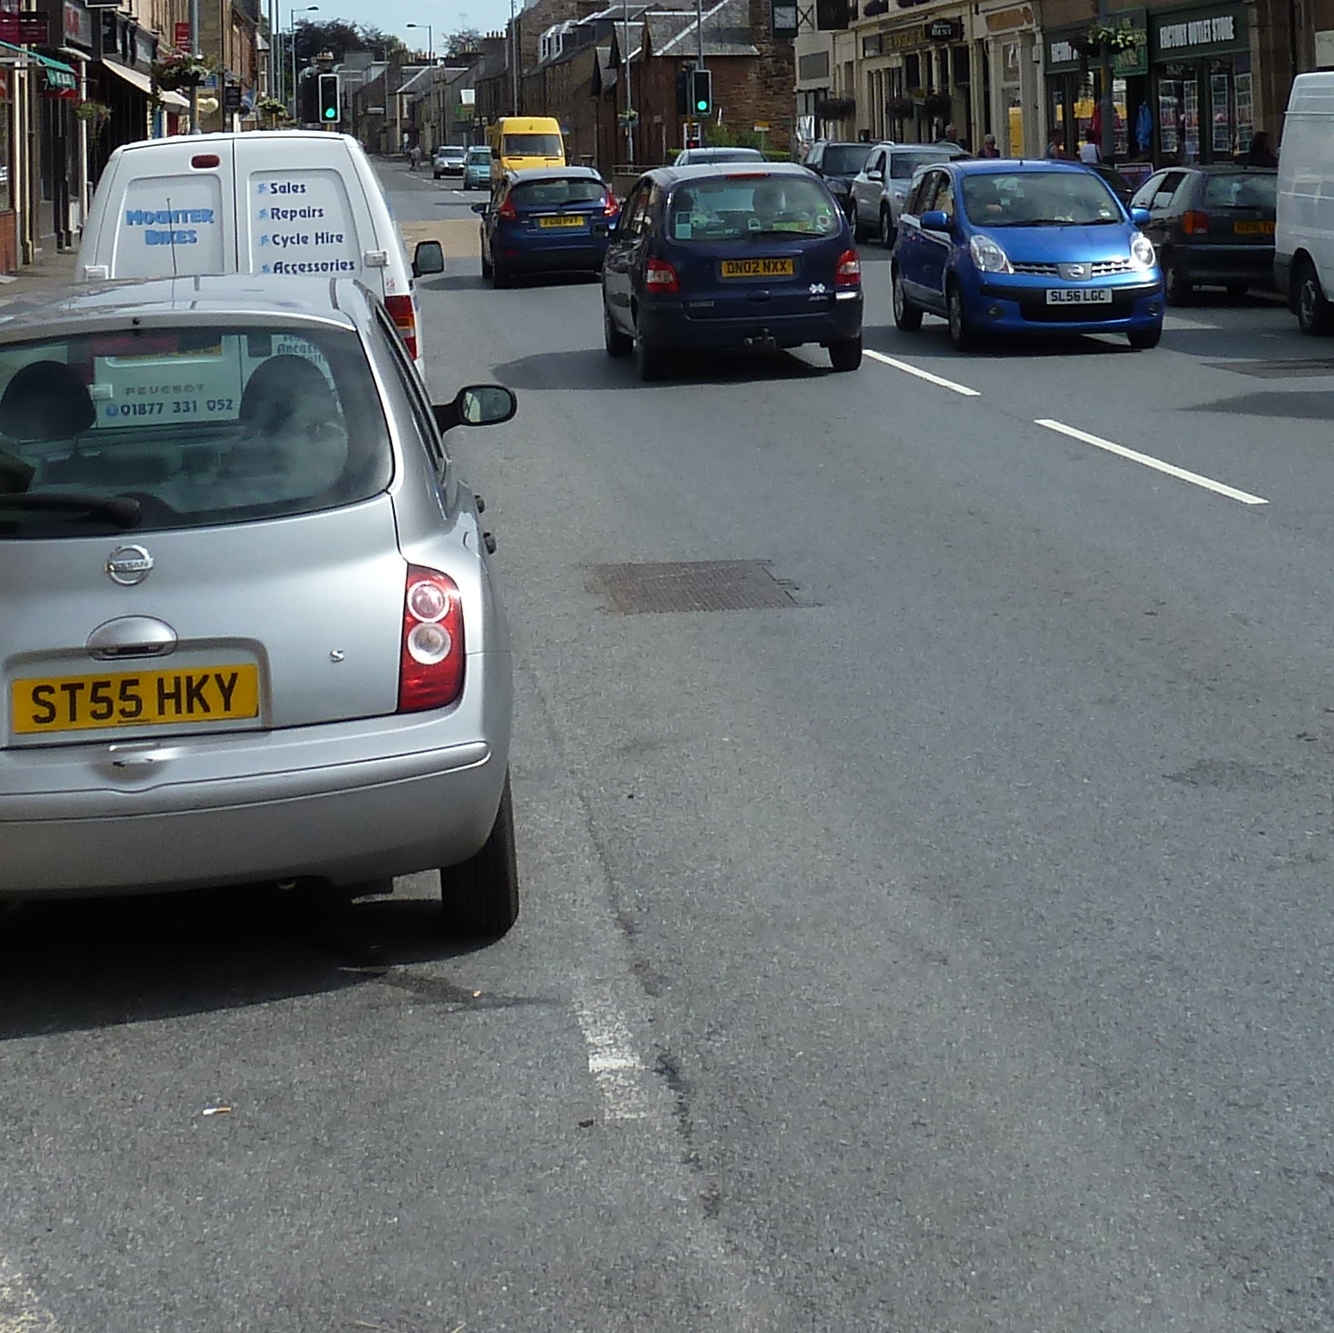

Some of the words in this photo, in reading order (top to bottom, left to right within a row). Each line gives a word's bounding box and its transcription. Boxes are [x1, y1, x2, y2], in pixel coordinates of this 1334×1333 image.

[931, 27, 953, 36] BEST
[1188, 18, 1212, 46] OUTLET
[1212, 16, 1236, 42] STORE
[270, 182, 307, 195] Sales
[270, 206, 325, 222] Repairs
[145, 229, 198, 247] BIKES
[271, 232, 309, 249] Cycle
[314, 231, 344, 245] Hire
[273, 259, 355, 275] Accessories
[727, 261, 760, 275] DN02
[762, 259, 788, 273] NXX
[1051, 290, 1081, 302] SL56
[1083, 289, 1105, 301] LGC
[125, 383, 205, 396] PEUGEOT
[120, 402, 164, 416] 01877
[172, 401, 197, 414] 331
[206, 398, 233, 412] 052
[31, 679, 143, 724] ST55
[156, 672, 239, 716] HKY
